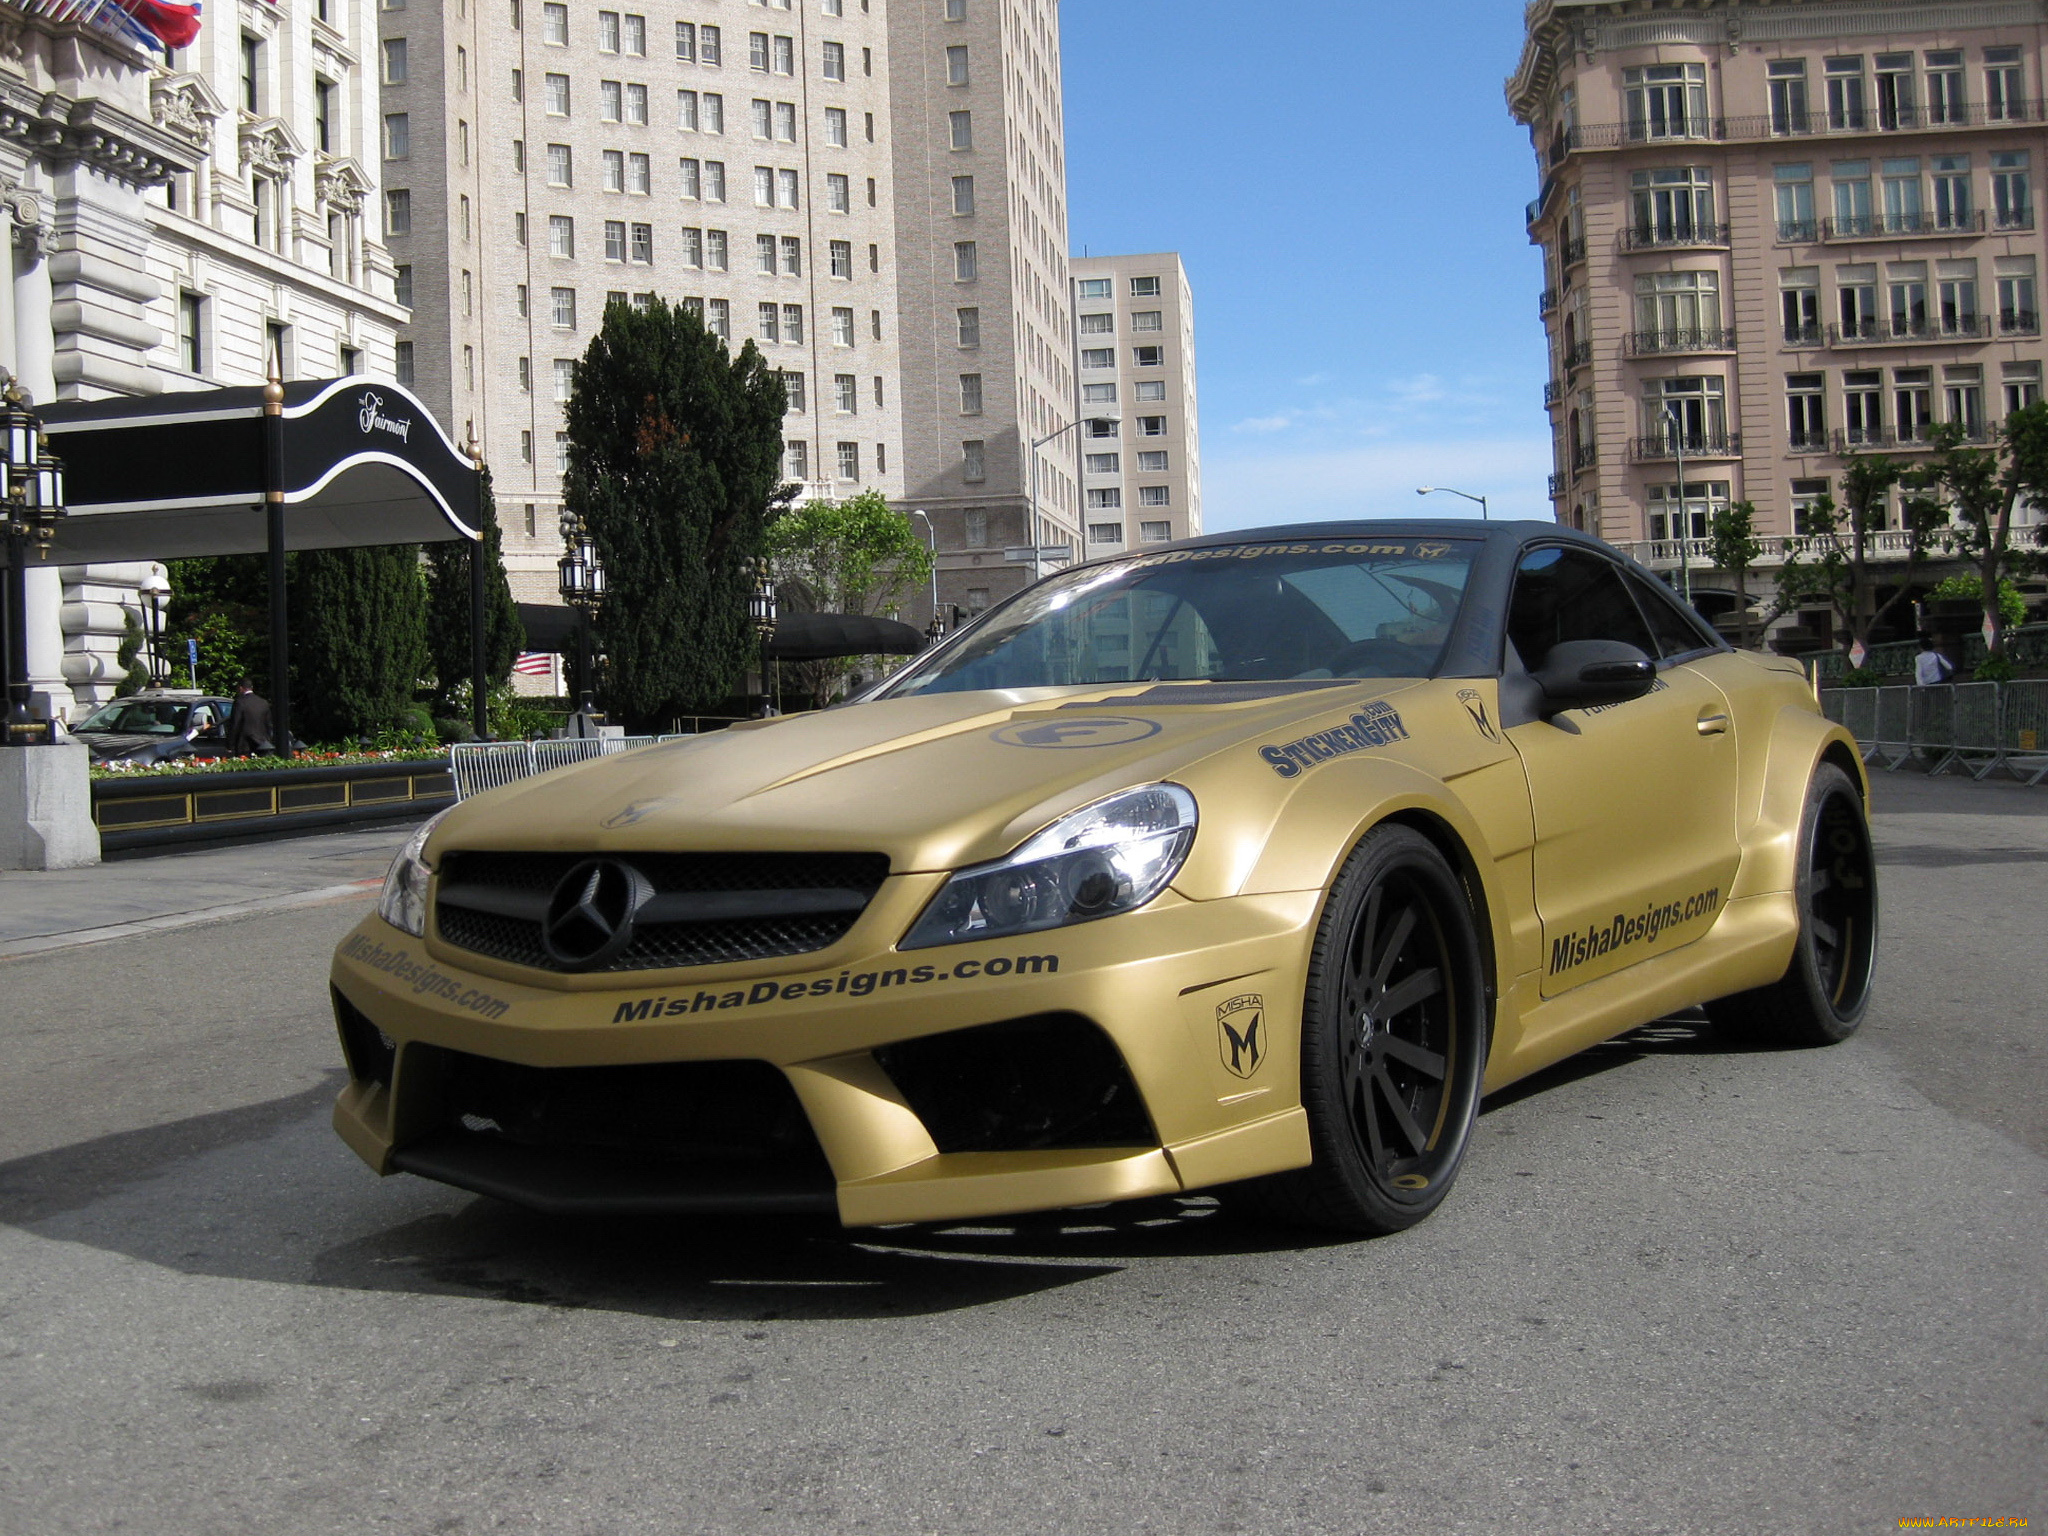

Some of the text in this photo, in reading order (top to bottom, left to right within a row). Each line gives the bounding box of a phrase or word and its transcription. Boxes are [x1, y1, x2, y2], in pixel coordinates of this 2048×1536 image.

[359, 391, 412, 444] Fairmont
[1068, 544, 1406, 580] aDesigns.com
[1549, 887, 1719, 976] MishaDesigns.com
[342, 934, 510, 1020] MishaDesigns.com
[612, 954, 1060, 1024] MishaDesigns.com
[1218, 996, 1261, 1017] MISHA
